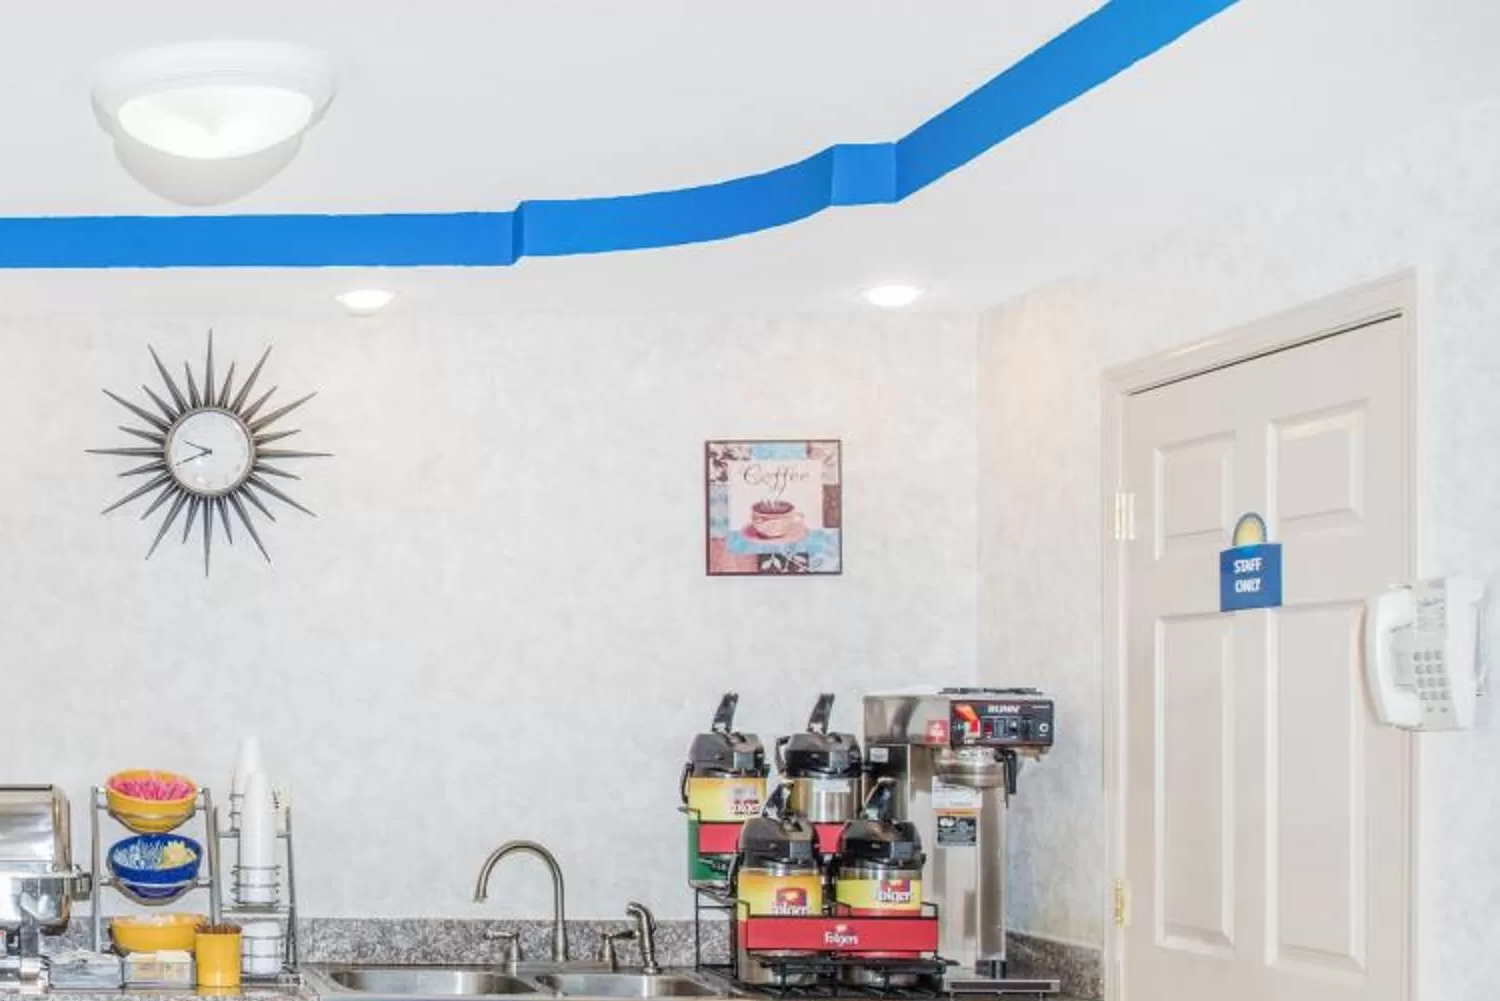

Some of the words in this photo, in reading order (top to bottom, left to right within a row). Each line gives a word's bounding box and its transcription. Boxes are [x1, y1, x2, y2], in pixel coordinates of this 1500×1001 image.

[1233, 557, 1263, 574] STAFF
[1235, 578, 1261, 593] ONLY
[987, 704, 1020, 714] BUNN
[824, 931, 859, 946] Folgers
